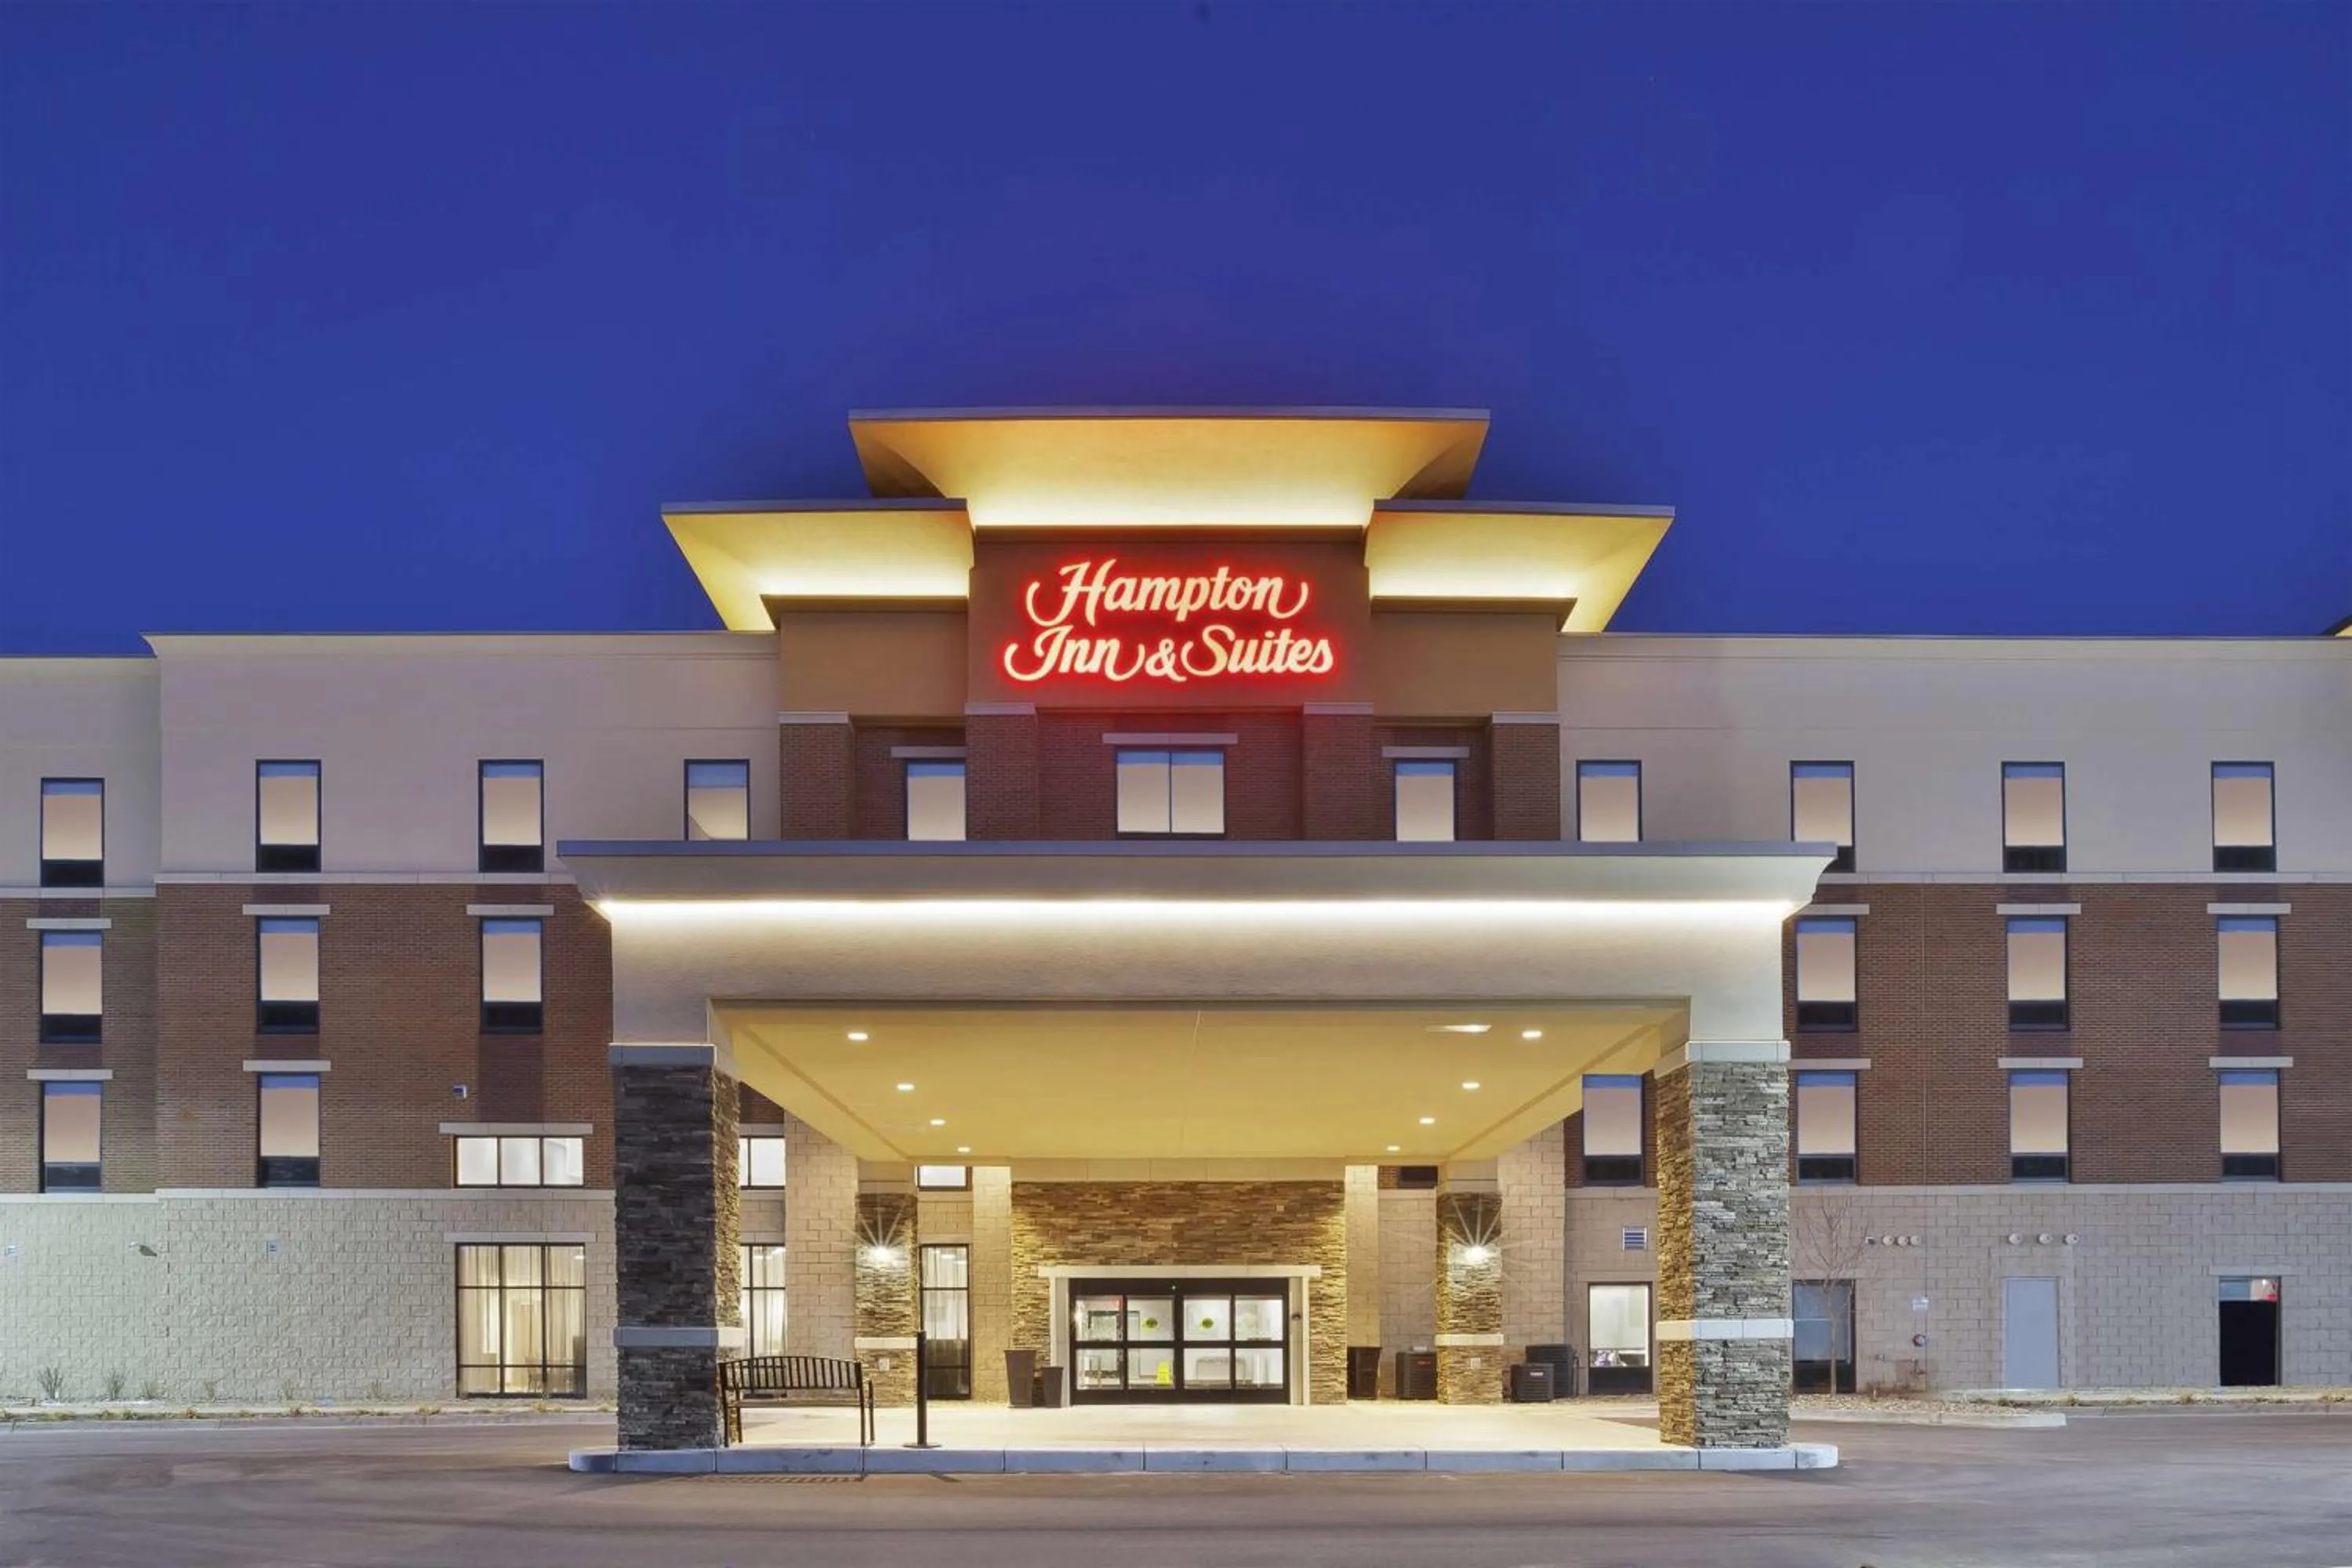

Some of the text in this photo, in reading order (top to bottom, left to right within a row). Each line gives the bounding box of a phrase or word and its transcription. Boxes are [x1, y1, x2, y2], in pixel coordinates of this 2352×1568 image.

[1026, 558, 1308, 626] Hampton
[1004, 625, 1334, 681] Inn & Suites
